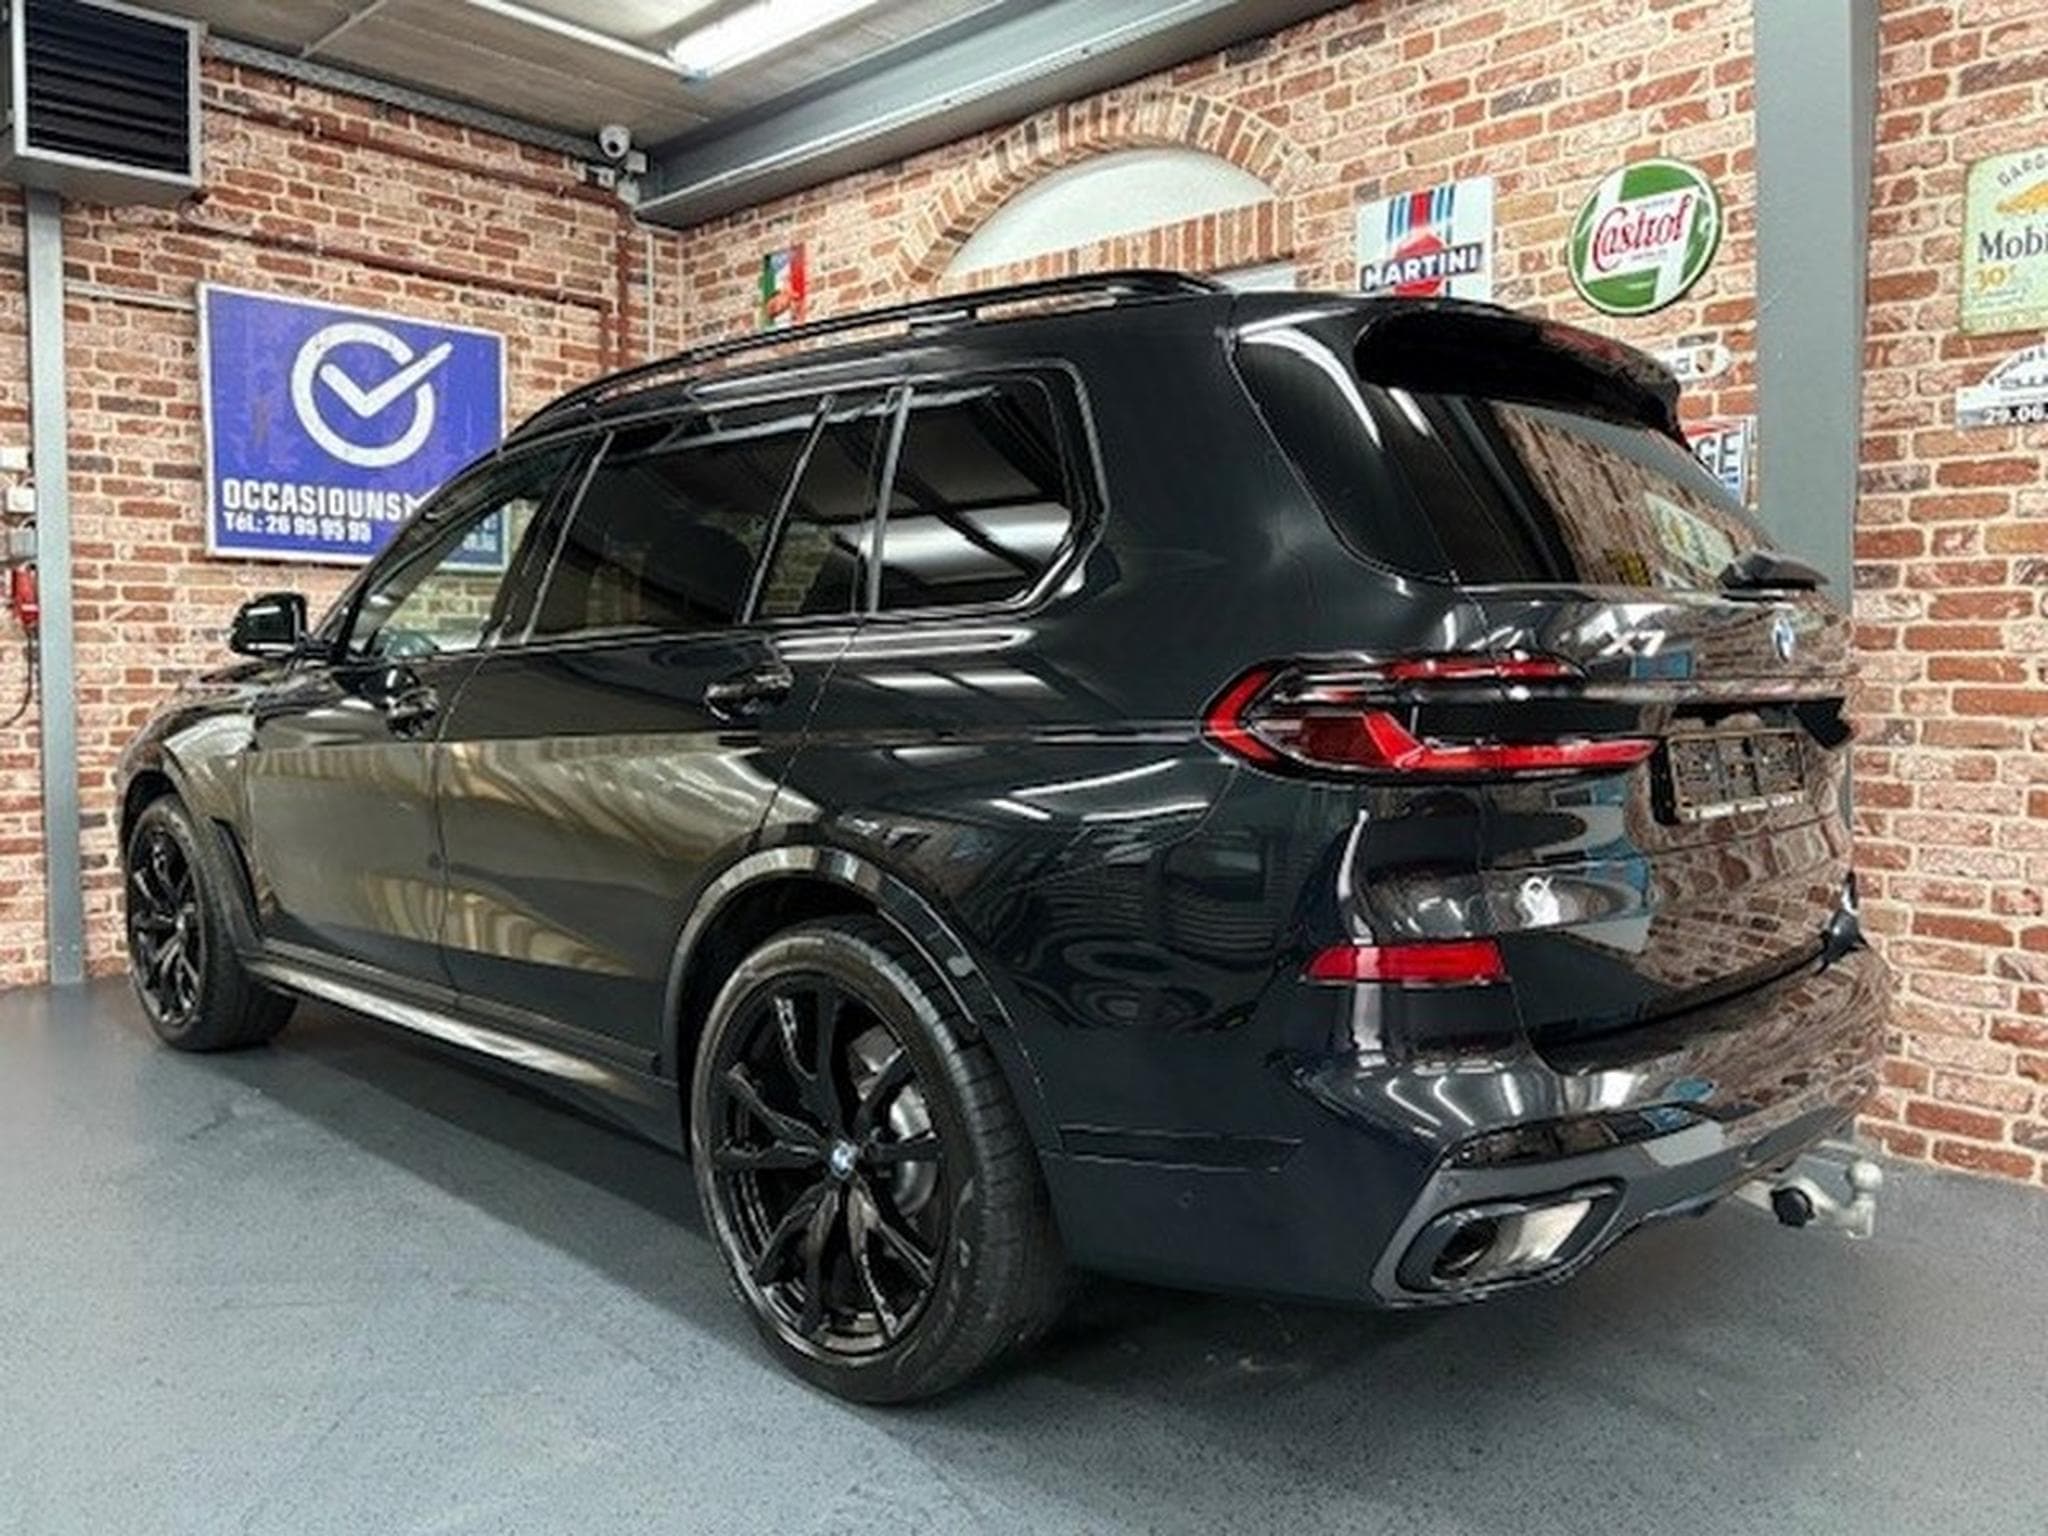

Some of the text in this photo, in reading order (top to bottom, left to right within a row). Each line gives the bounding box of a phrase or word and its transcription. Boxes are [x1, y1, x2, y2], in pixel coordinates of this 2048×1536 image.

[1593, 194, 1693, 272] Castrol
[1364, 246, 1479, 291] MARTINI
[1601, 630, 1665, 657] X7
